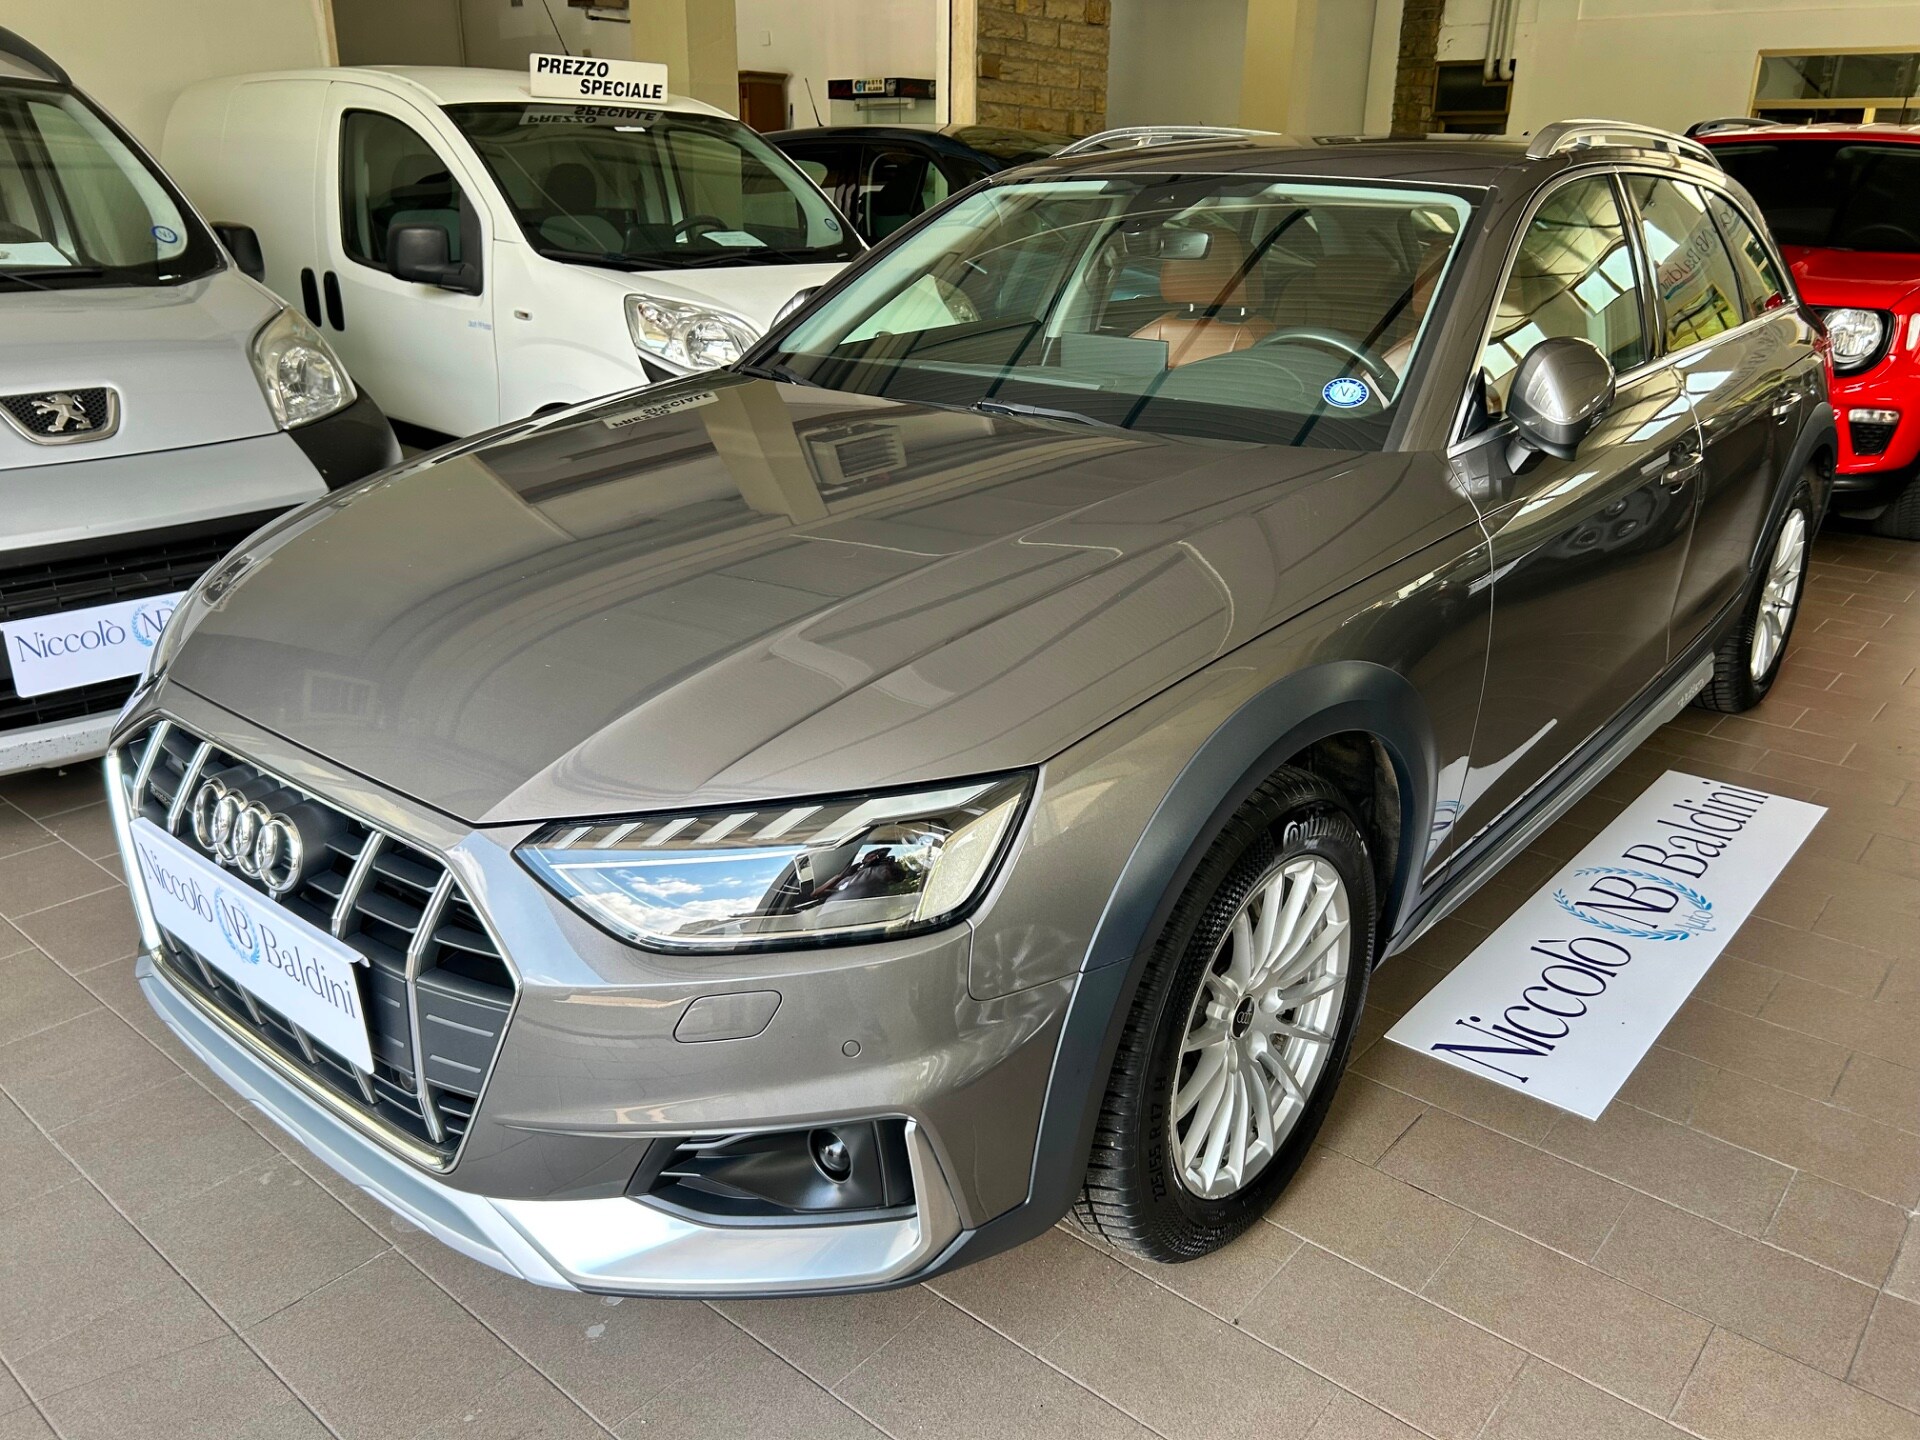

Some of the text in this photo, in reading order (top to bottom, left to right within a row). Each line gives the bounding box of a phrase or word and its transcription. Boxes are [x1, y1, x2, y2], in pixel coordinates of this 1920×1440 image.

[537, 57, 609, 77] PREZZO
[580, 79, 663, 99] SPECIALE
[14, 619, 126, 663] Niccolò
[139, 842, 356, 1019] Niccolò NB Baldini
[1431, 780, 1770, 1083] Niccolò NB Baldini
[1674, 908, 1717, 937] Auto
[1149, 1143, 1167, 1202] 225/55
